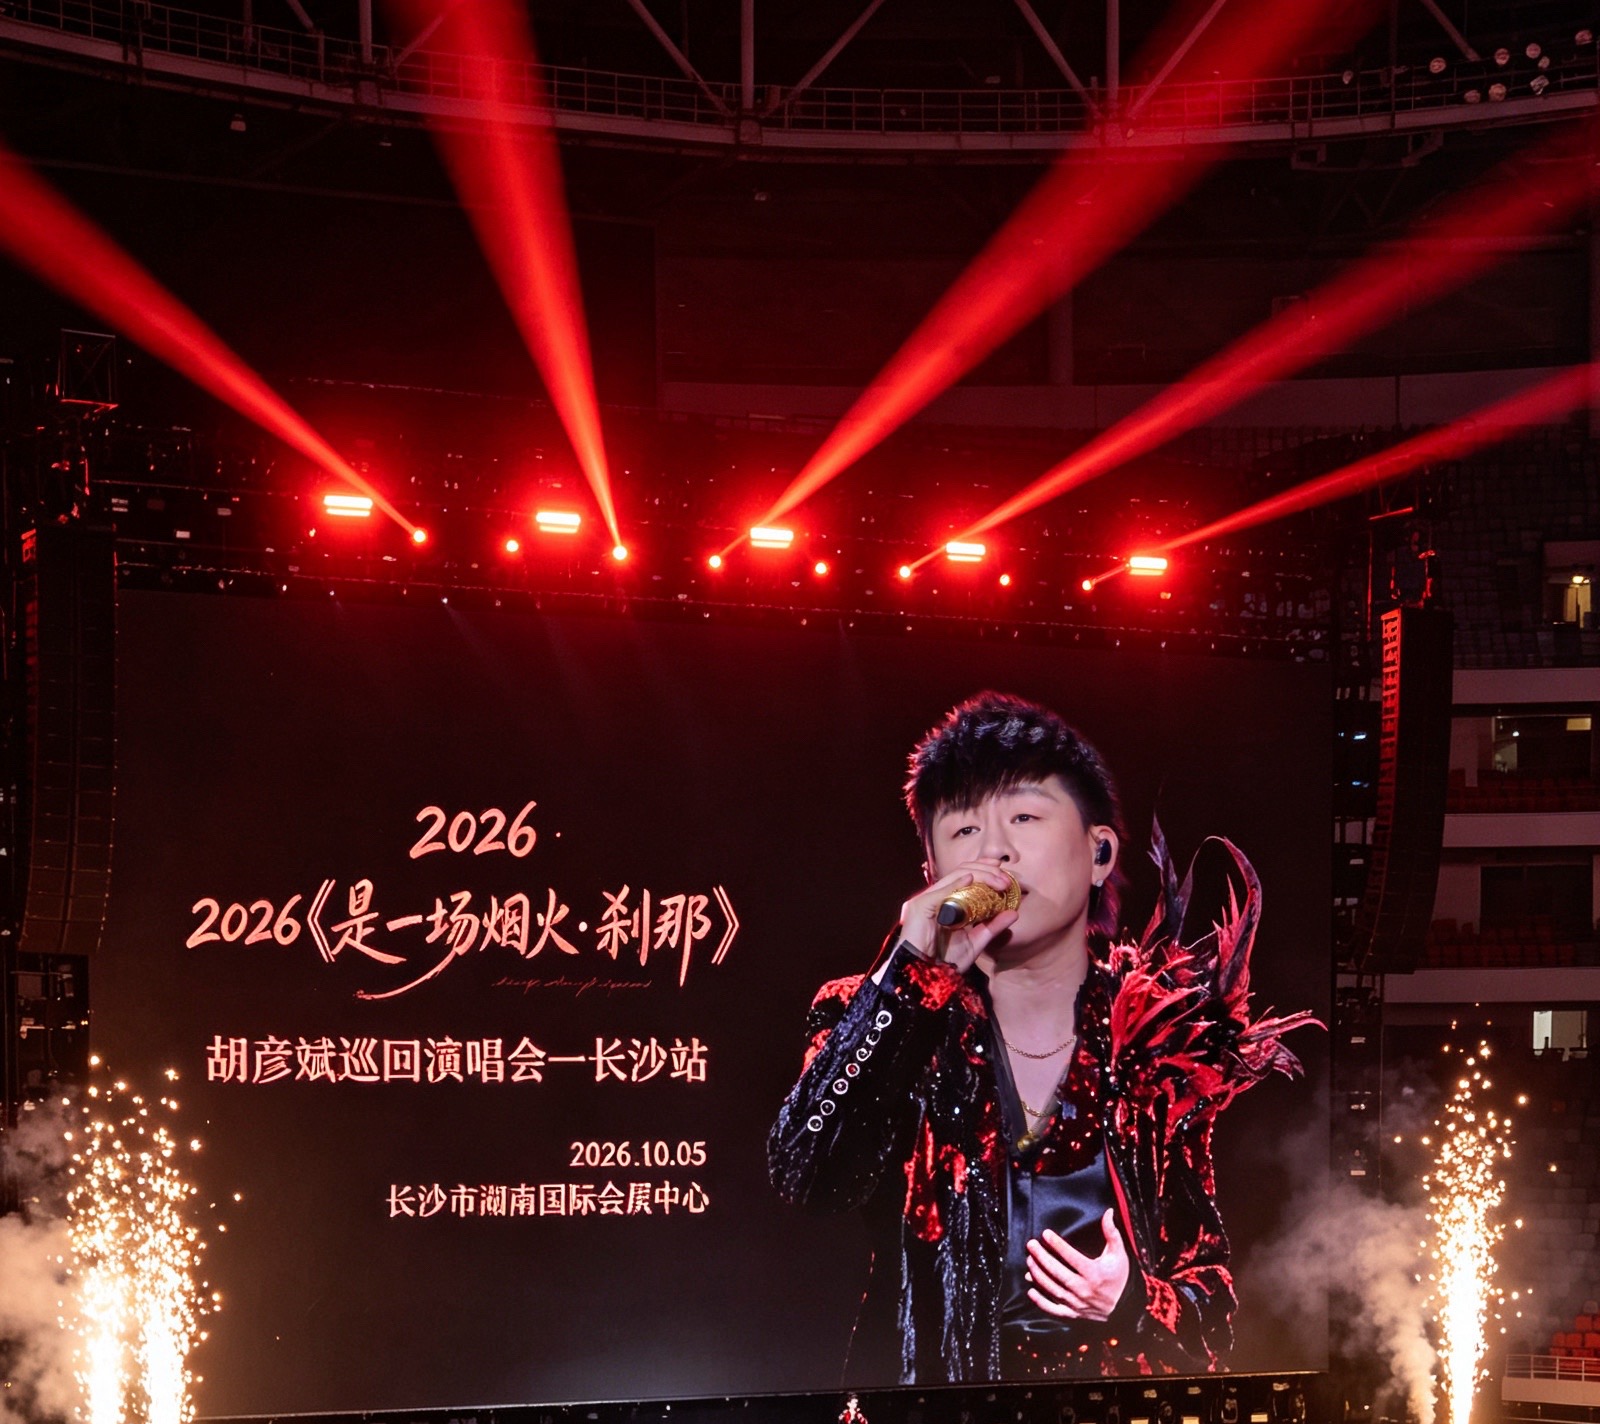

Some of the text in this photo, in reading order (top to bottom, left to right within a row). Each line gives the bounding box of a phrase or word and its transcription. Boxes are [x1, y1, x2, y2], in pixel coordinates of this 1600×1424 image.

[568, 1140, 708, 1168] 2026.10.05
[385, 1179, 711, 1218] 长沙市湖南国际会展中心
